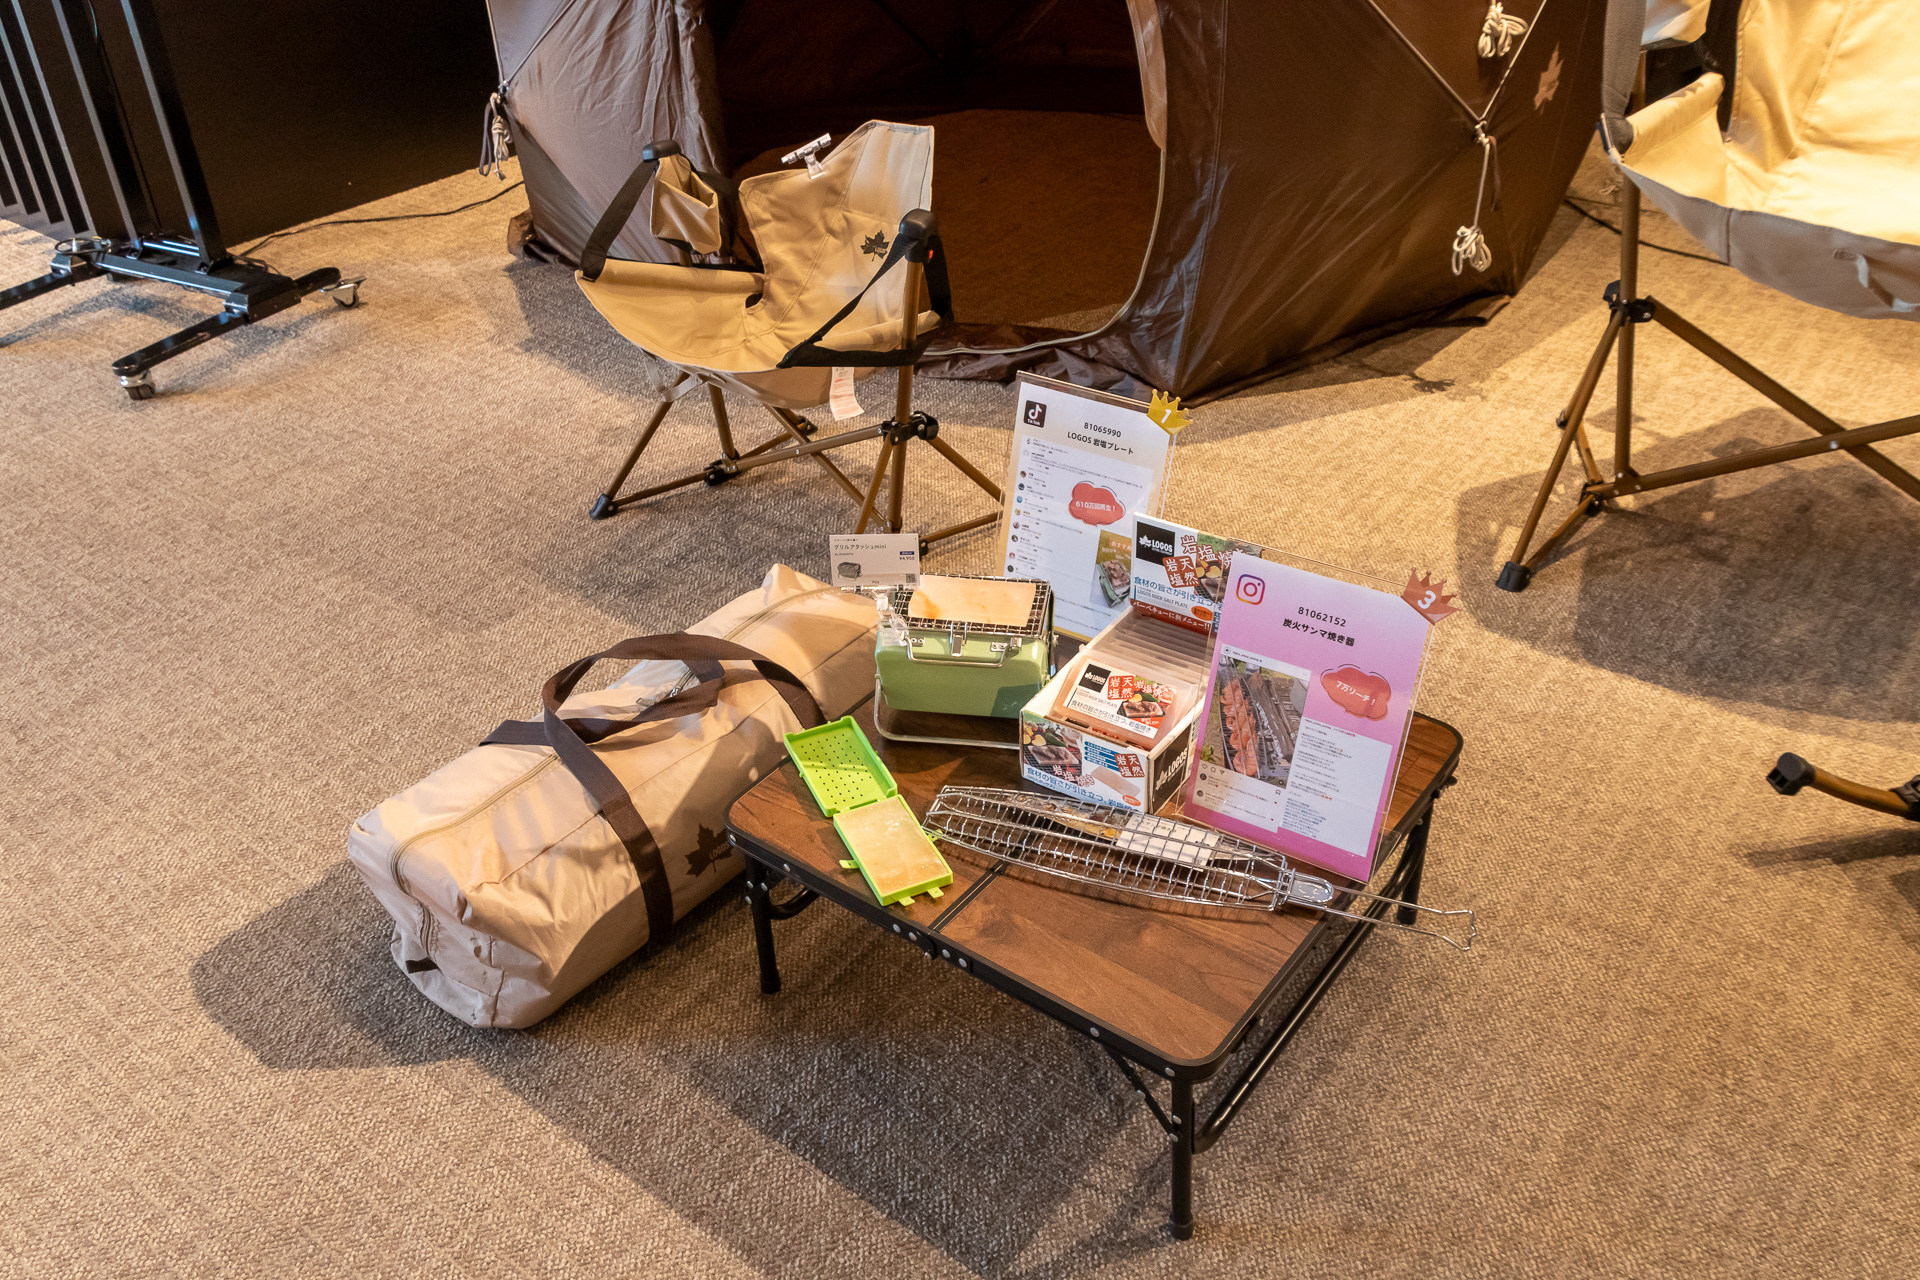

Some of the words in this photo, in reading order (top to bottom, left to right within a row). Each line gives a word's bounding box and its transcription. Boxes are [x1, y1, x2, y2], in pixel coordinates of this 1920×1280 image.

[1161, 408, 1171, 424] 1
[1083, 421, 1122, 438] 81065990
[1067, 431, 1092, 444] LOGOS
[1093, 437, 1134, 455] 岩塩プレート
[1151, 539, 1173, 553] LOGOS
[1416, 589, 1437, 610] 3
[1297, 606, 1347, 628] 81062152
[1282, 617, 1355, 647] 炭火サンマ焼き器
[1167, 746, 1188, 777] LOGOS
[709, 841, 730, 860] LOGOS
